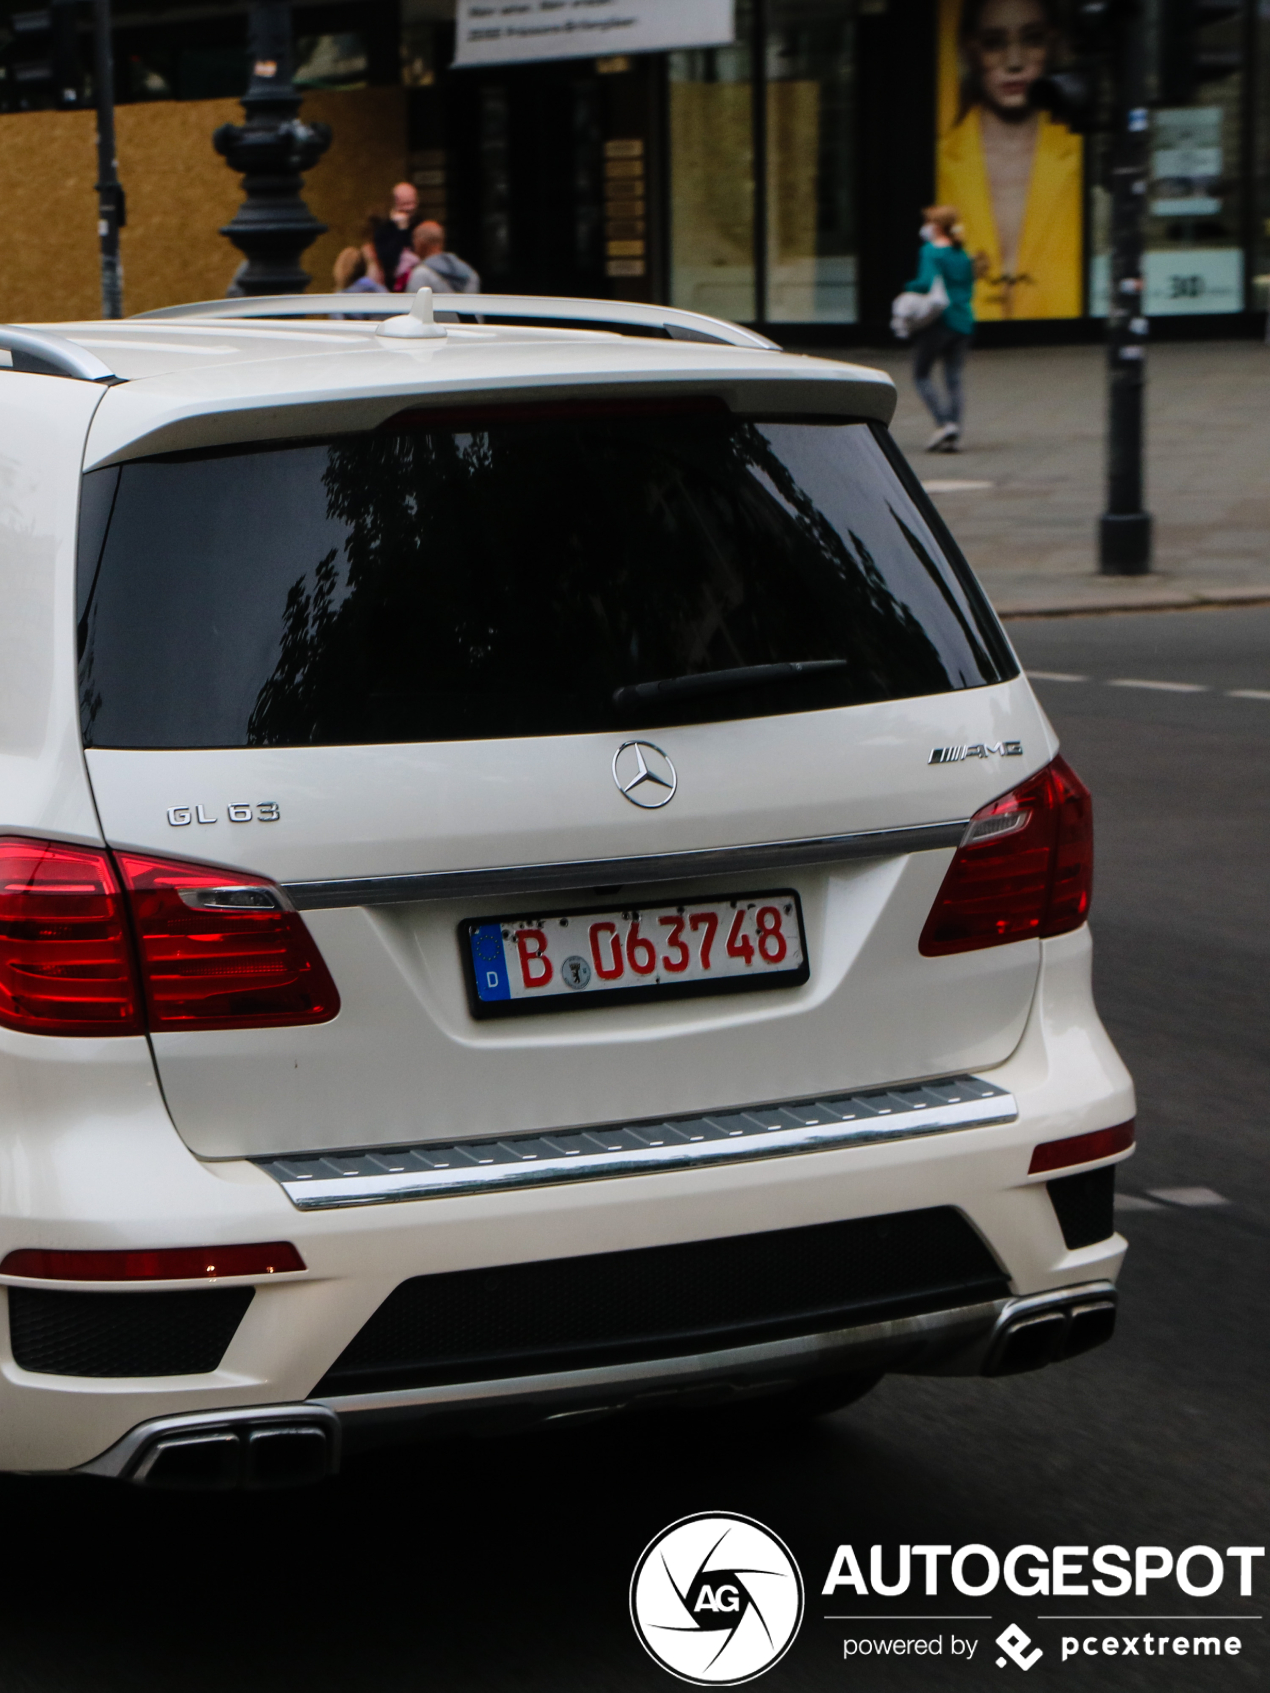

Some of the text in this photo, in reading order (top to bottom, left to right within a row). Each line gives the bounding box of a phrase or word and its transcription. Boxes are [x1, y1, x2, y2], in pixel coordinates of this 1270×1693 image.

[167, 801, 280, 827] GL 63
[516, 928, 553, 989] B
[589, 905, 787, 981] 063748
[486, 971, 499, 988] D
